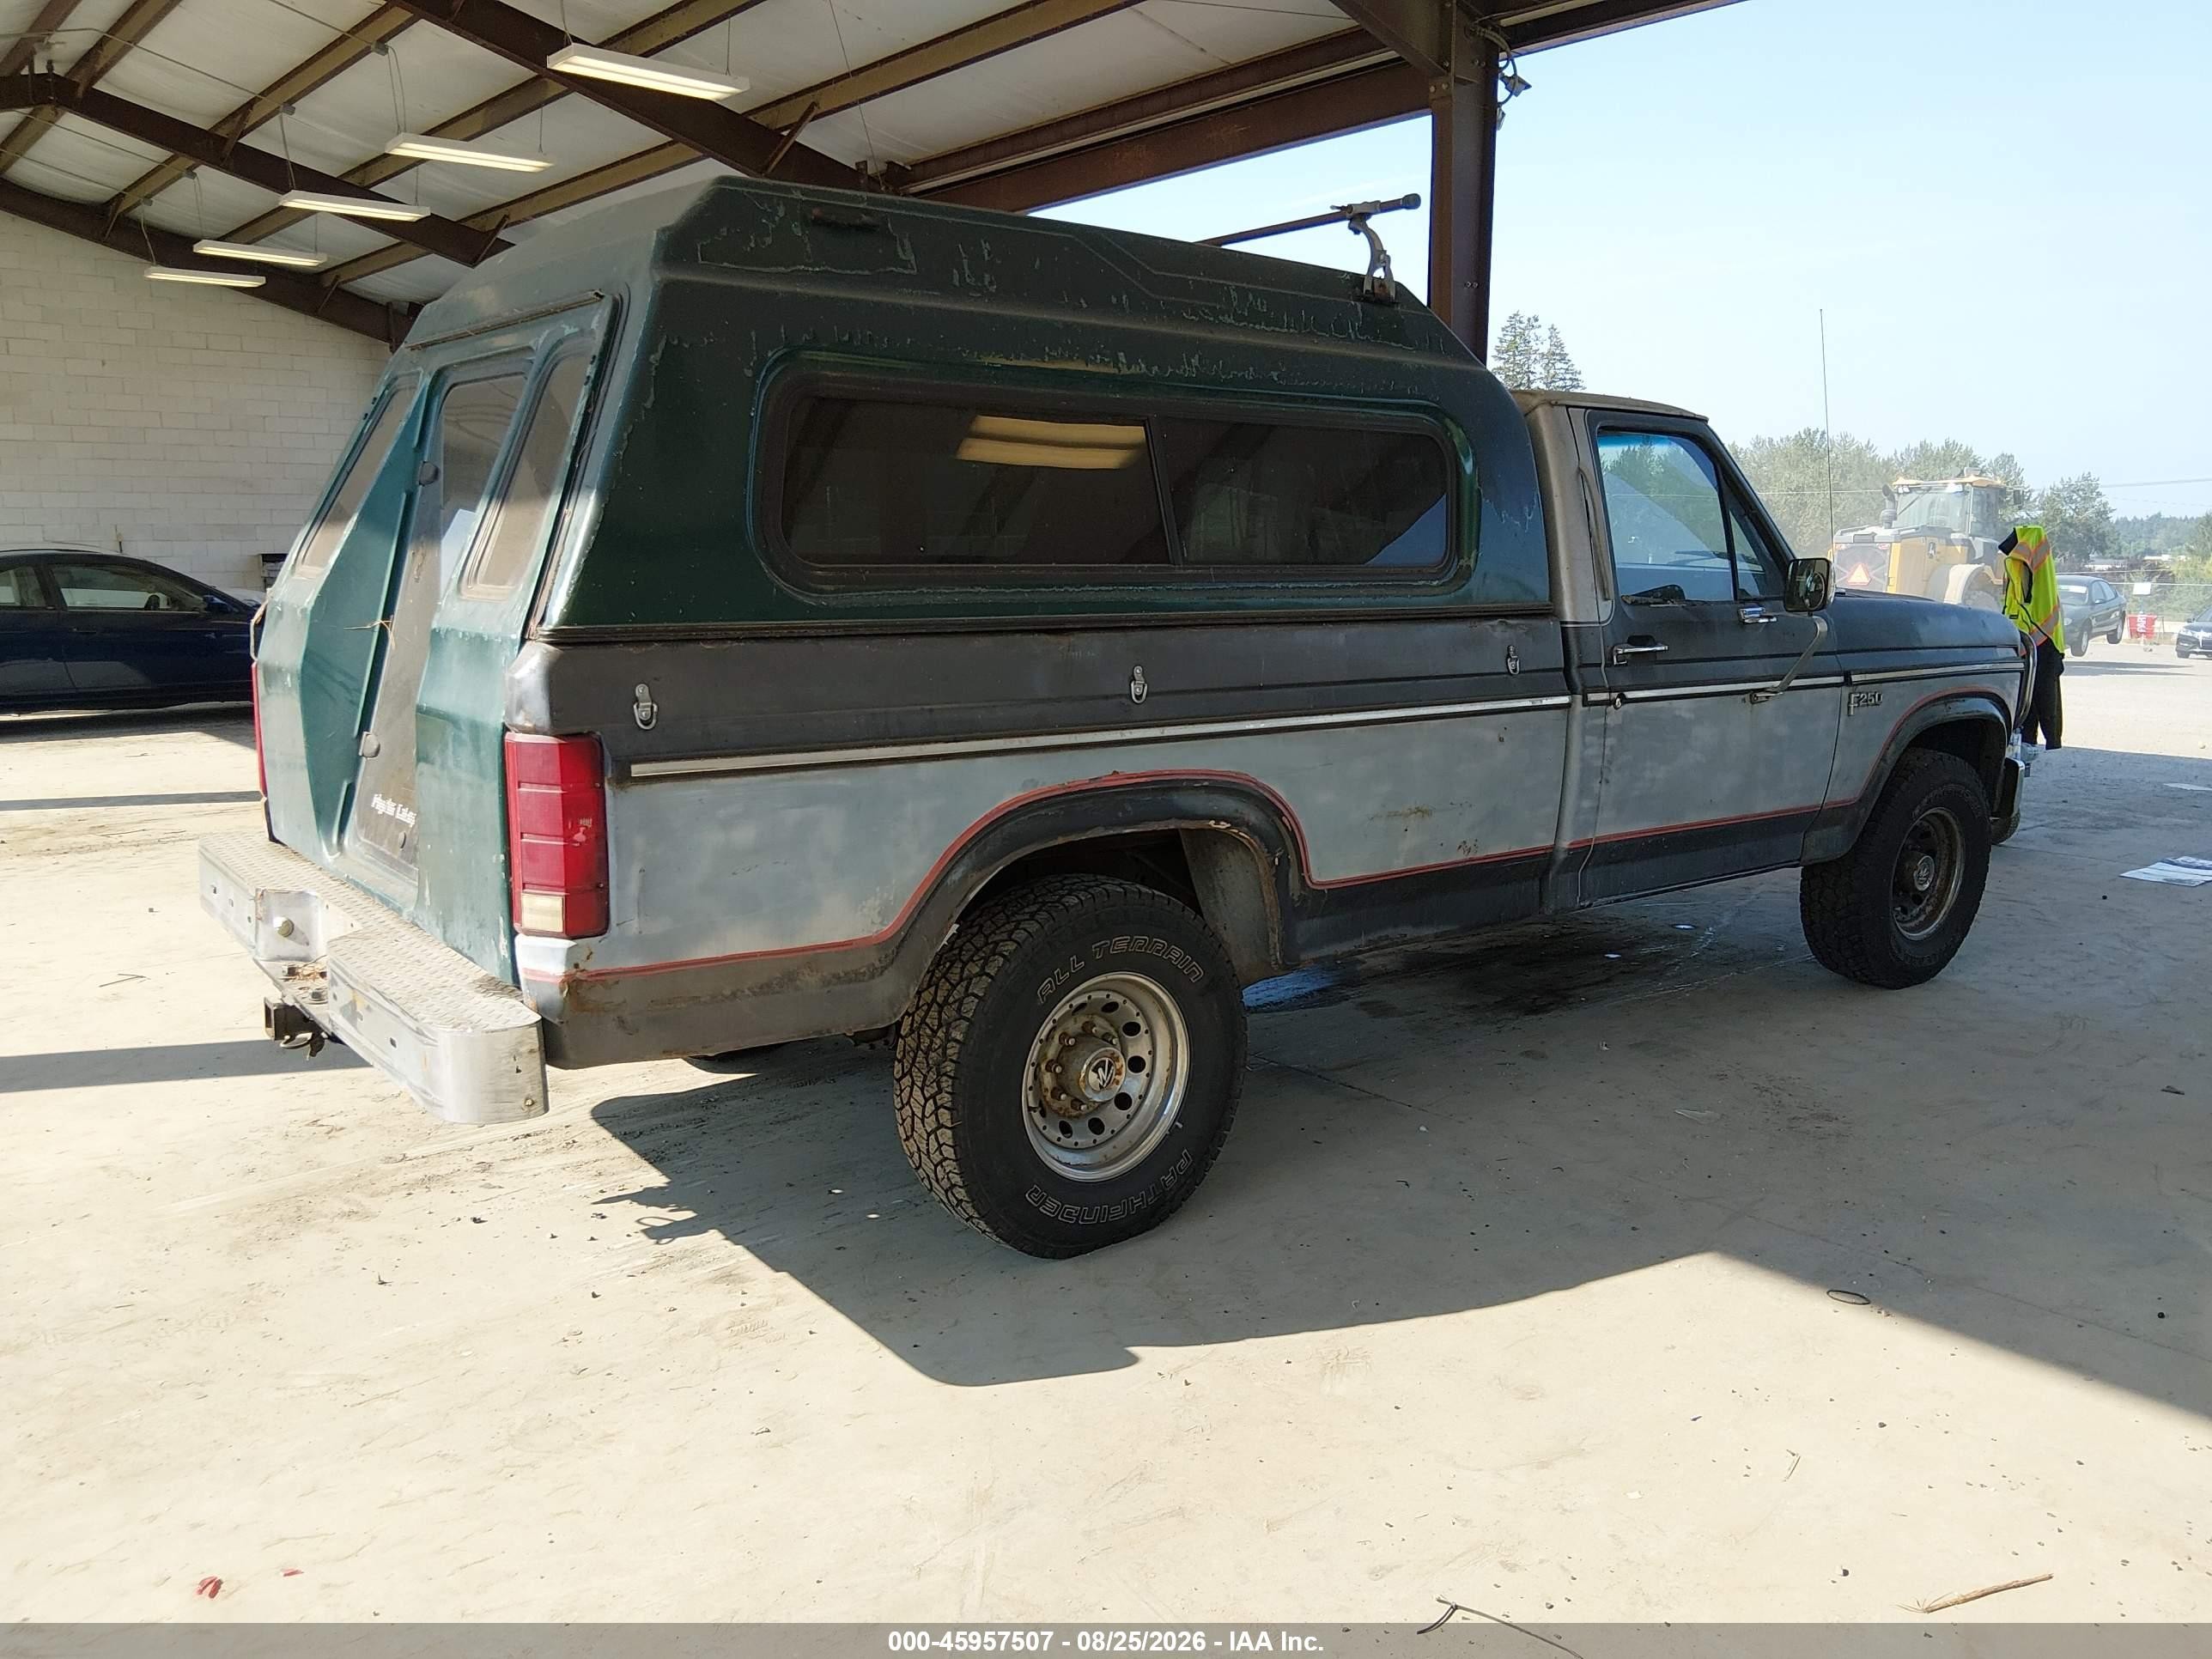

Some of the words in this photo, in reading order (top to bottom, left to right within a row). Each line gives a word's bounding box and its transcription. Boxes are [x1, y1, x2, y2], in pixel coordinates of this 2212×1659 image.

[1848, 693, 1883, 715] F250
[1036, 955, 1085, 1004] ALL
[1091, 935, 1204, 982] TERRAIN
[1024, 1147, 1194, 1224] PATHFINDER
